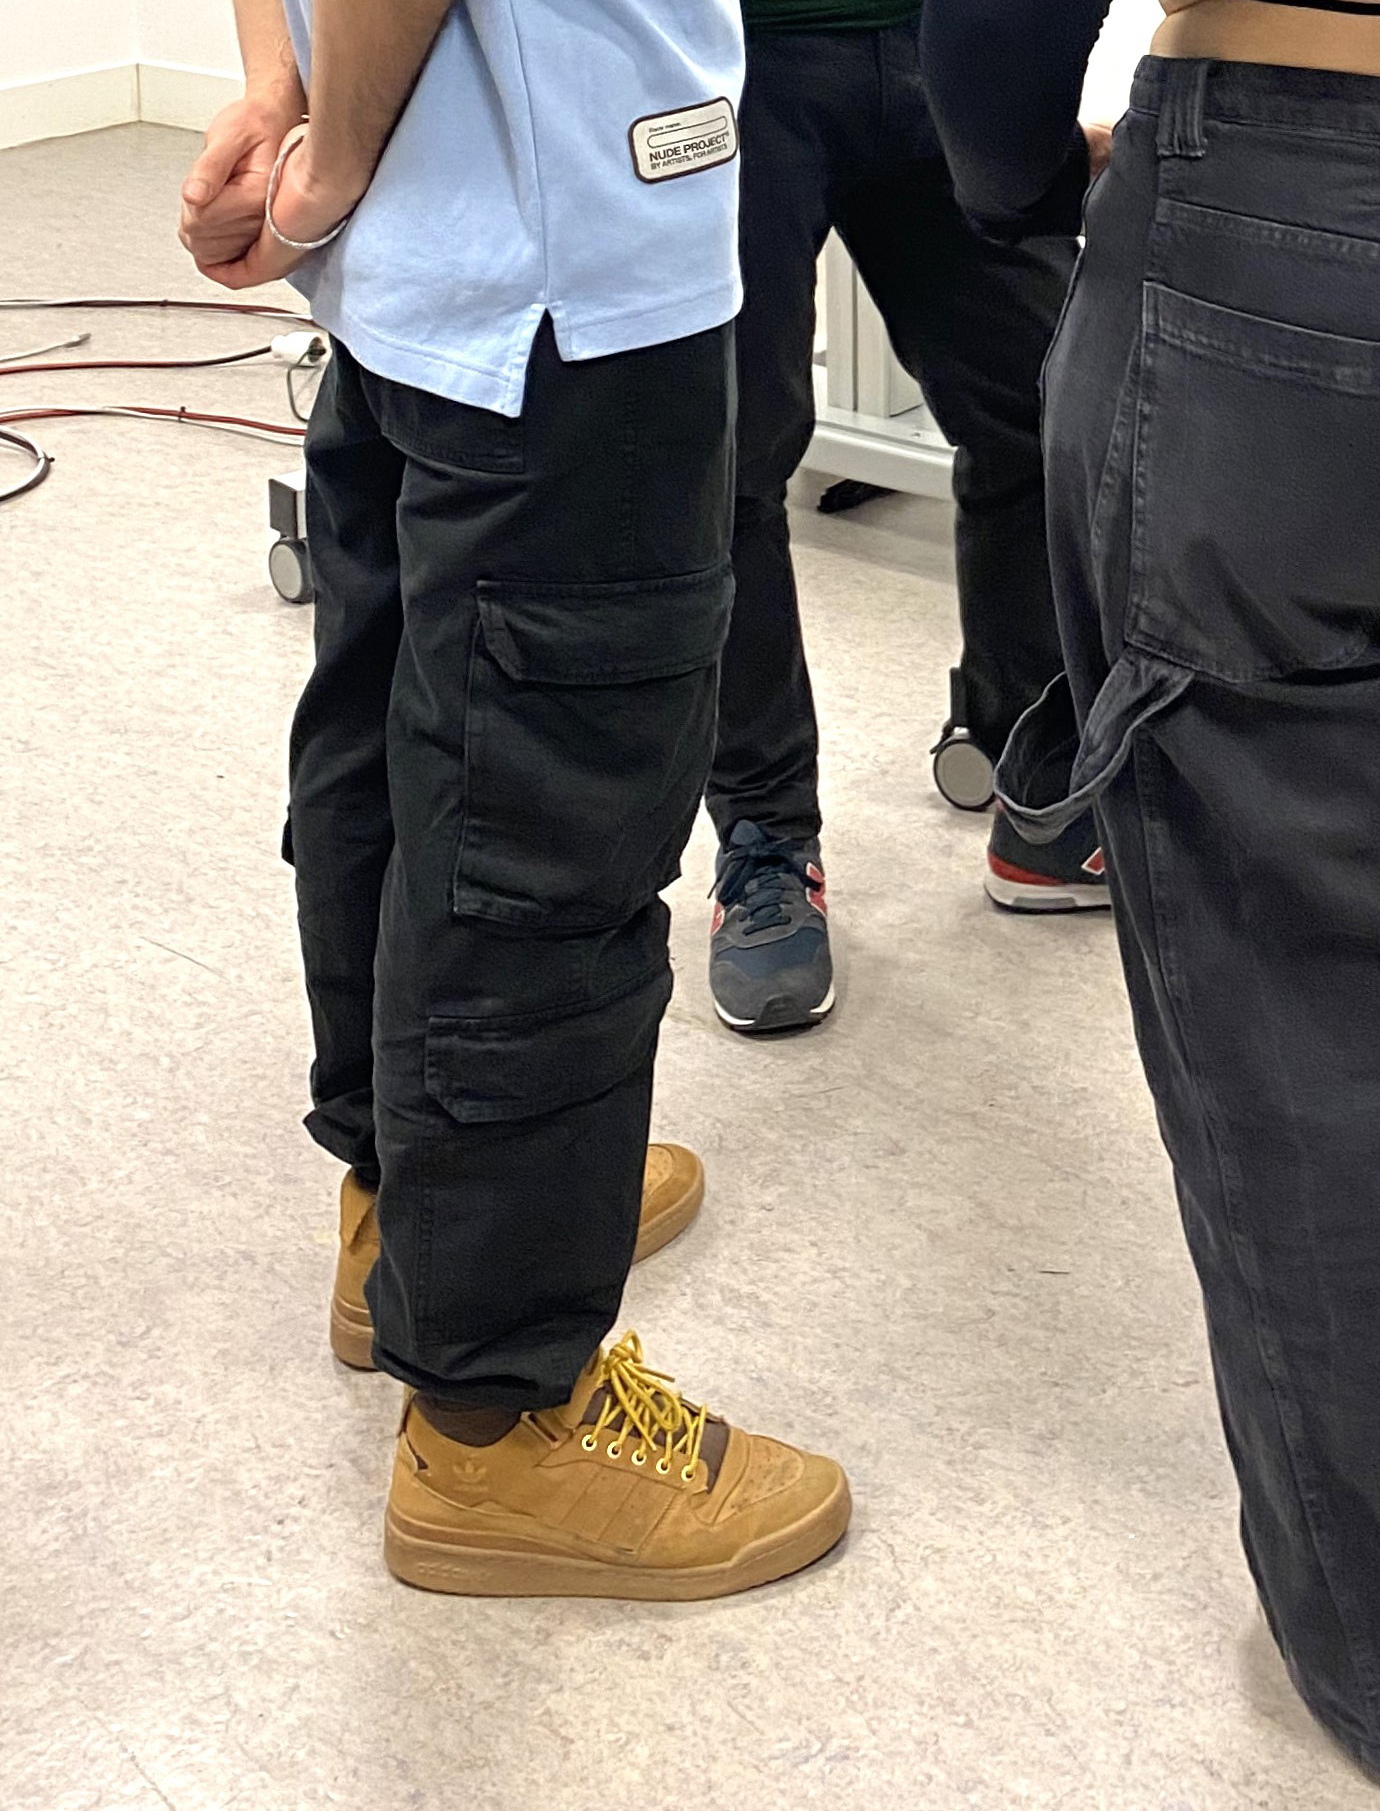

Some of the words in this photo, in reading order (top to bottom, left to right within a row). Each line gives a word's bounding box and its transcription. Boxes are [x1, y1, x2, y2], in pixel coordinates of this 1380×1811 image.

[649, 146, 681, 162] NUDE
[683, 133, 726, 153] PROJECT
[651, 161, 662, 170] BY
[693, 150, 706, 160] FOR
